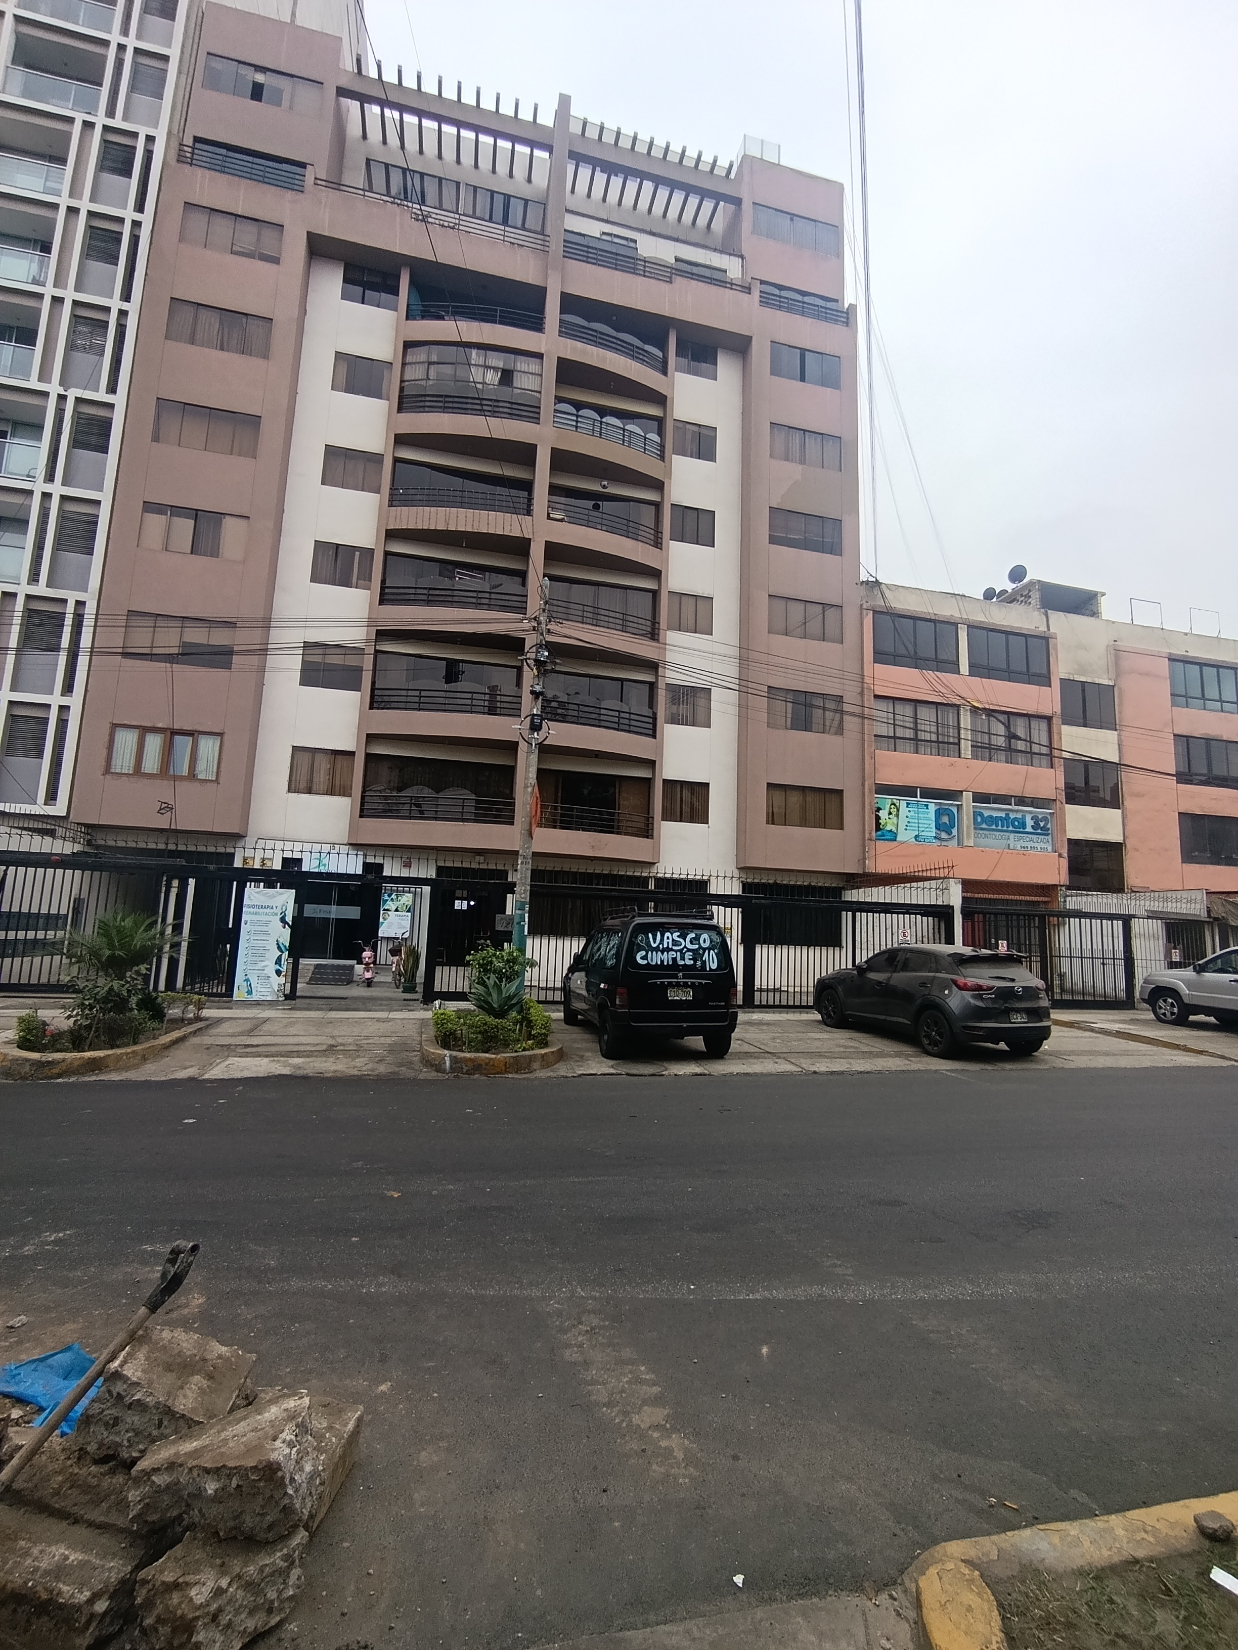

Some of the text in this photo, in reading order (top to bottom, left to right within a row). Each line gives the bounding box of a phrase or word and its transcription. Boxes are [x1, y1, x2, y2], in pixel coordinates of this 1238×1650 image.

[973, 810, 1050, 832] Dental 32
[1014, 835, 1050, 844] ESPECIALIZADA
[648, 931, 711, 950] VASCO
[636, 949, 718, 971] CUMPLE 10
